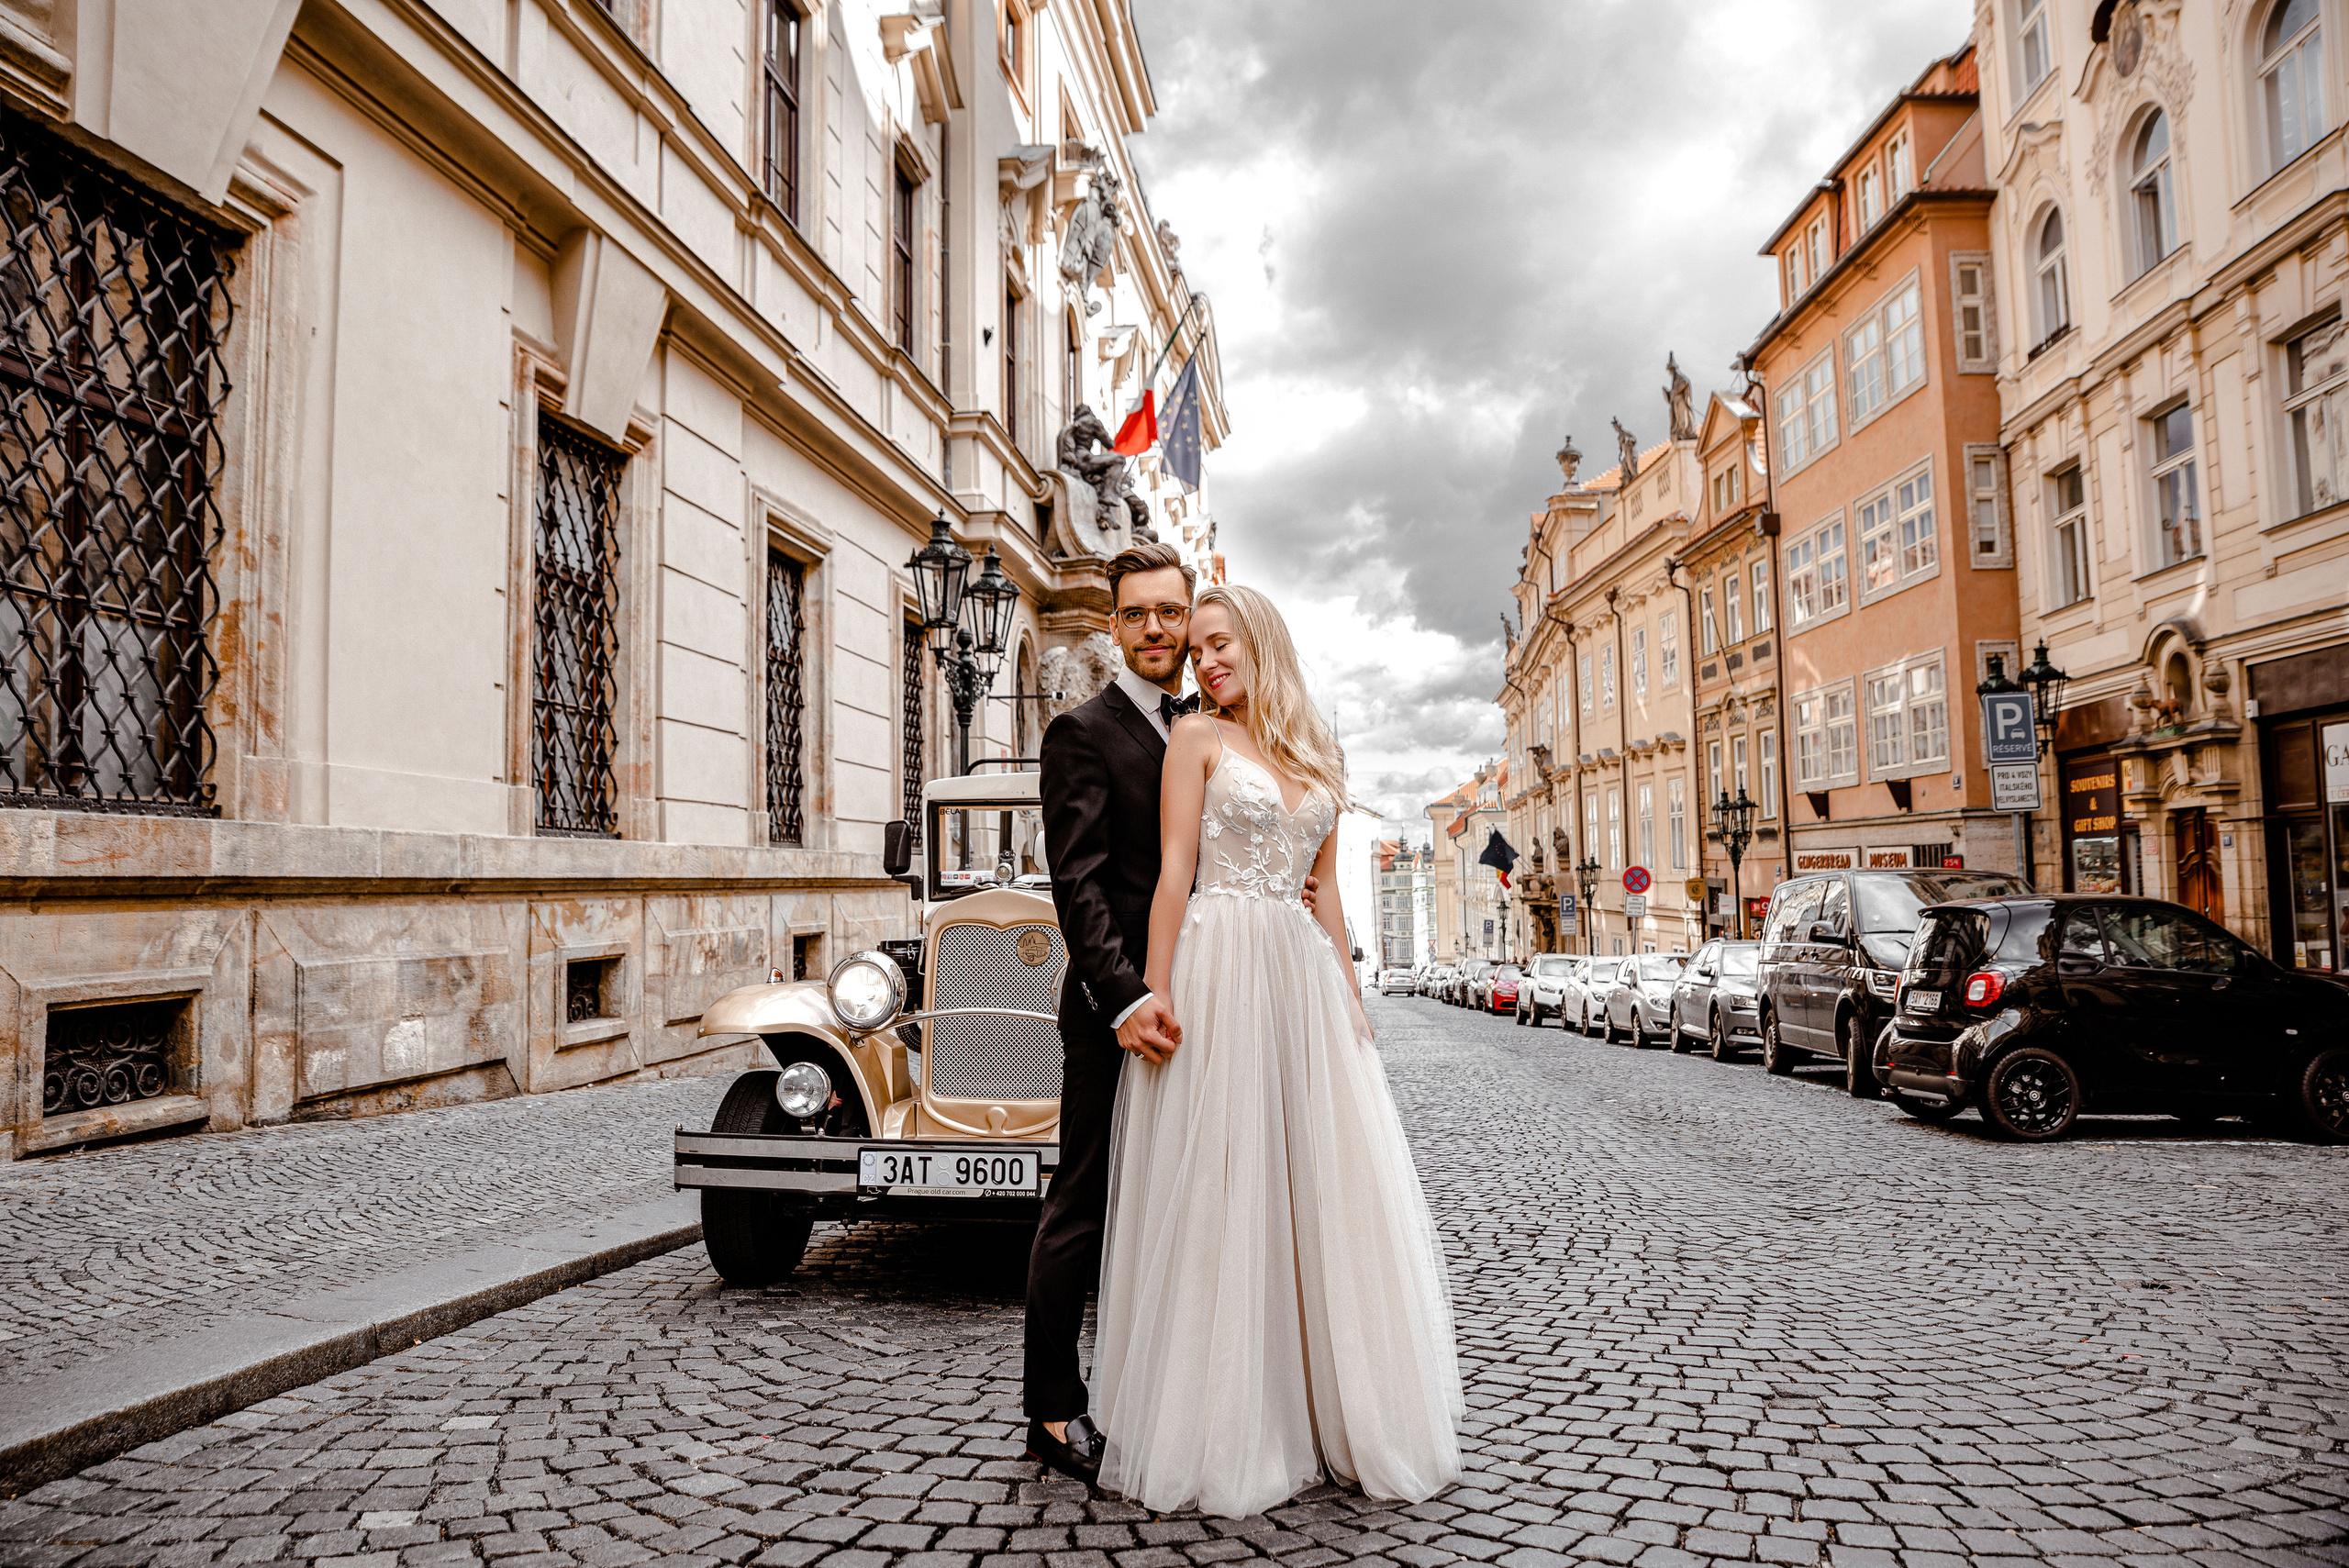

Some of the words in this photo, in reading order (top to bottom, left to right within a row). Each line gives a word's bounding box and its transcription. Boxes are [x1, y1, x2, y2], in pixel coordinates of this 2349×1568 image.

[1995, 702, 2023, 740] P
[2070, 773, 2116, 793] SOUVENIRS
[2089, 796, 2098, 810] &
[2074, 817, 2092, 832] GIFT
[2092, 816, 2116, 831] SHOP
[1798, 853, 1851, 869] GINGERBREAD
[1869, 852, 1908, 868] MUSEUM
[1563, 897, 1573, 911] P
[1486, 921, 1492, 929] P
[862, 1173, 875, 1184] CZ
[883, 1156, 932, 1184] 3AT
[955, 1157, 1024, 1185] 9600
